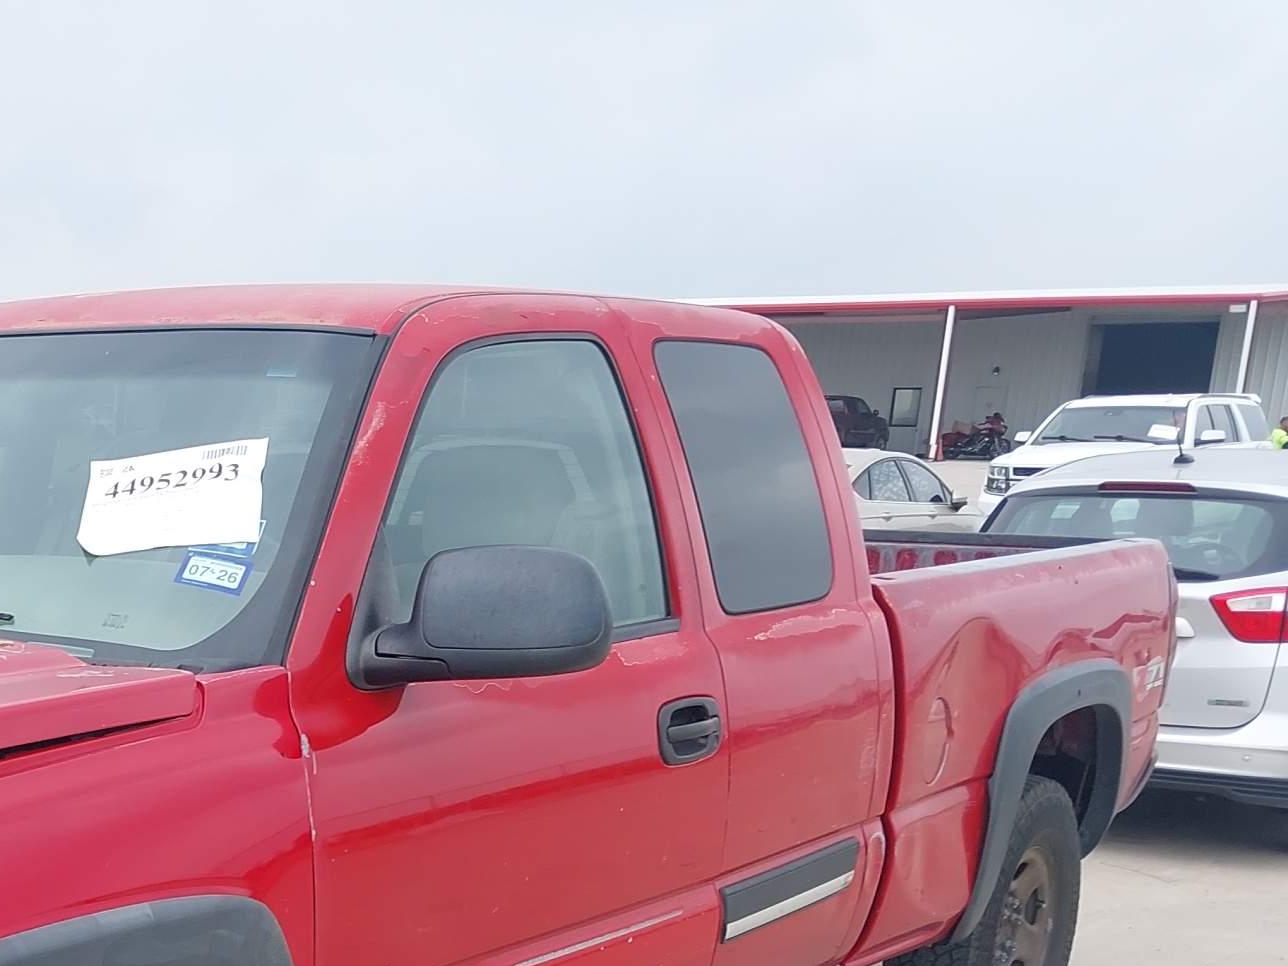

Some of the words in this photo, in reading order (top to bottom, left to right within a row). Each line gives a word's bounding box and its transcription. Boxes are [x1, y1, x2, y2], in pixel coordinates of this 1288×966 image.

[104, 462, 239, 498] 44952993
[188, 564, 211, 577] 07
[216, 569, 240, 584] 26
